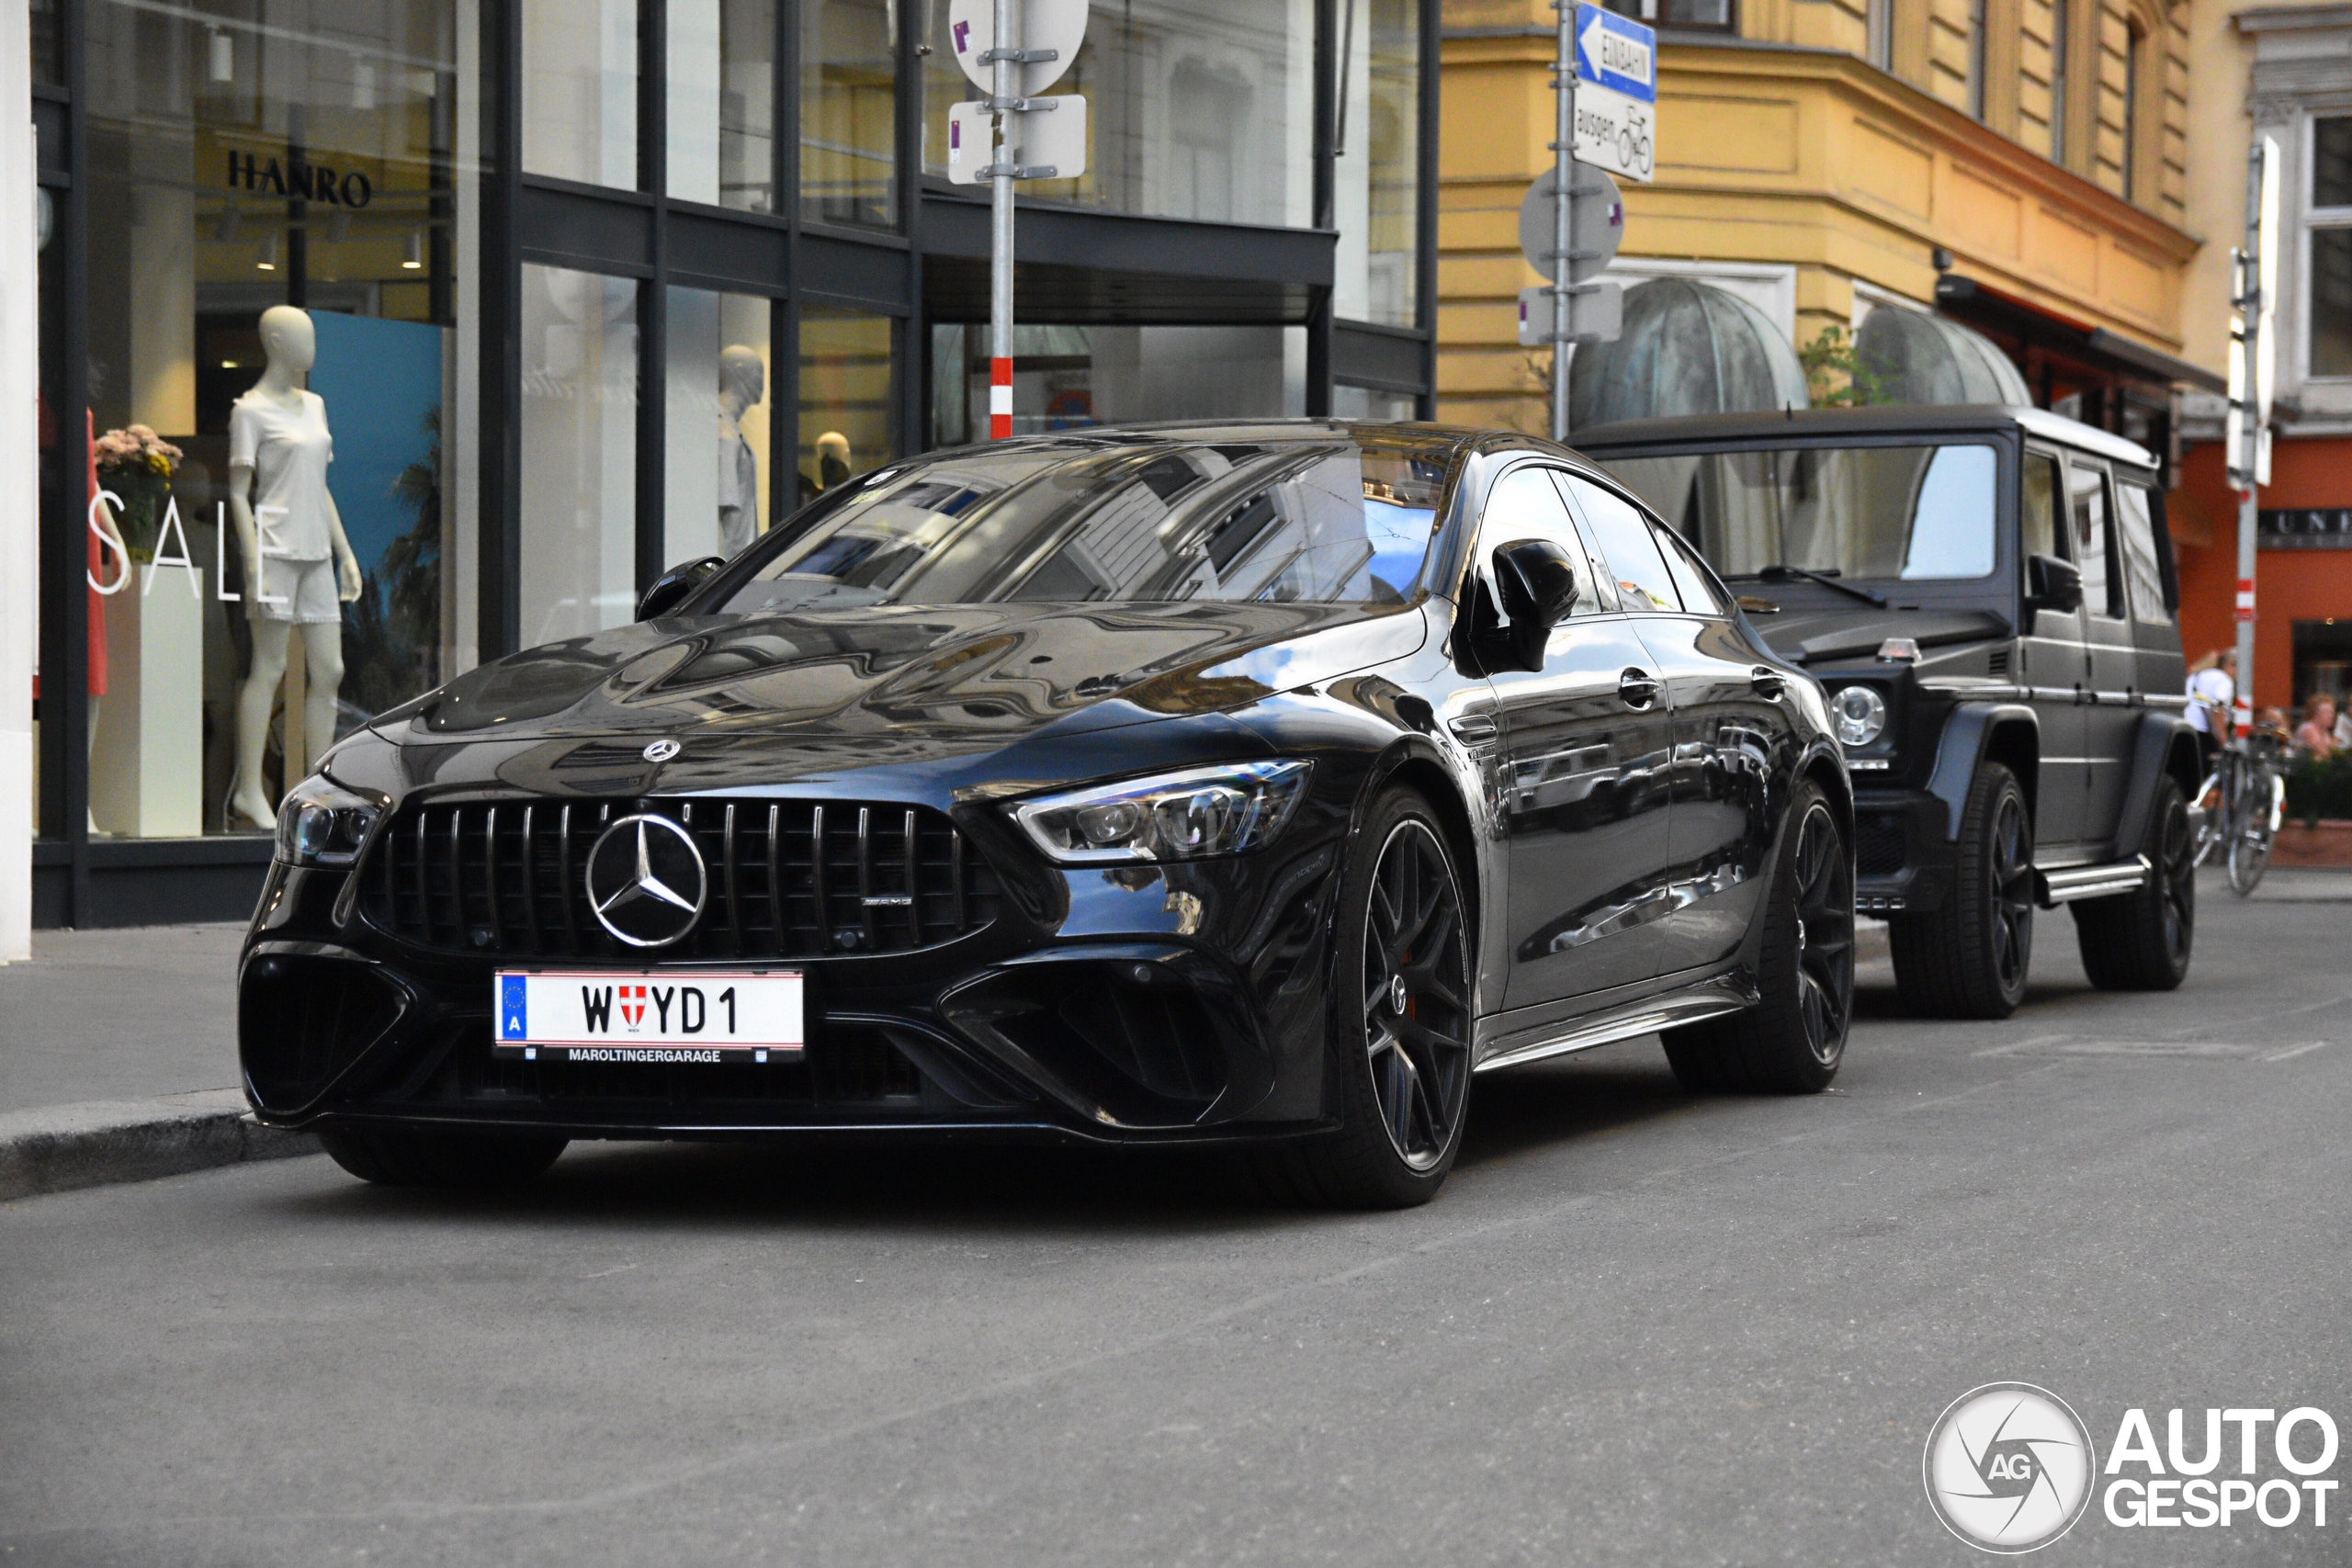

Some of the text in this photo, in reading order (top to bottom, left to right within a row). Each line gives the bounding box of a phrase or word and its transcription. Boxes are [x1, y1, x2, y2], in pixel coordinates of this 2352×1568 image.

[1601, 33, 1647, 80] EINBAHN
[229, 150, 371, 209] HANRO
[87, 490, 289, 604] SALE
[508, 1015, 521, 1032] A
[582, 985, 613, 1033] W
[568, 1048, 721, 1064] MAROLTINGERGARAGE
